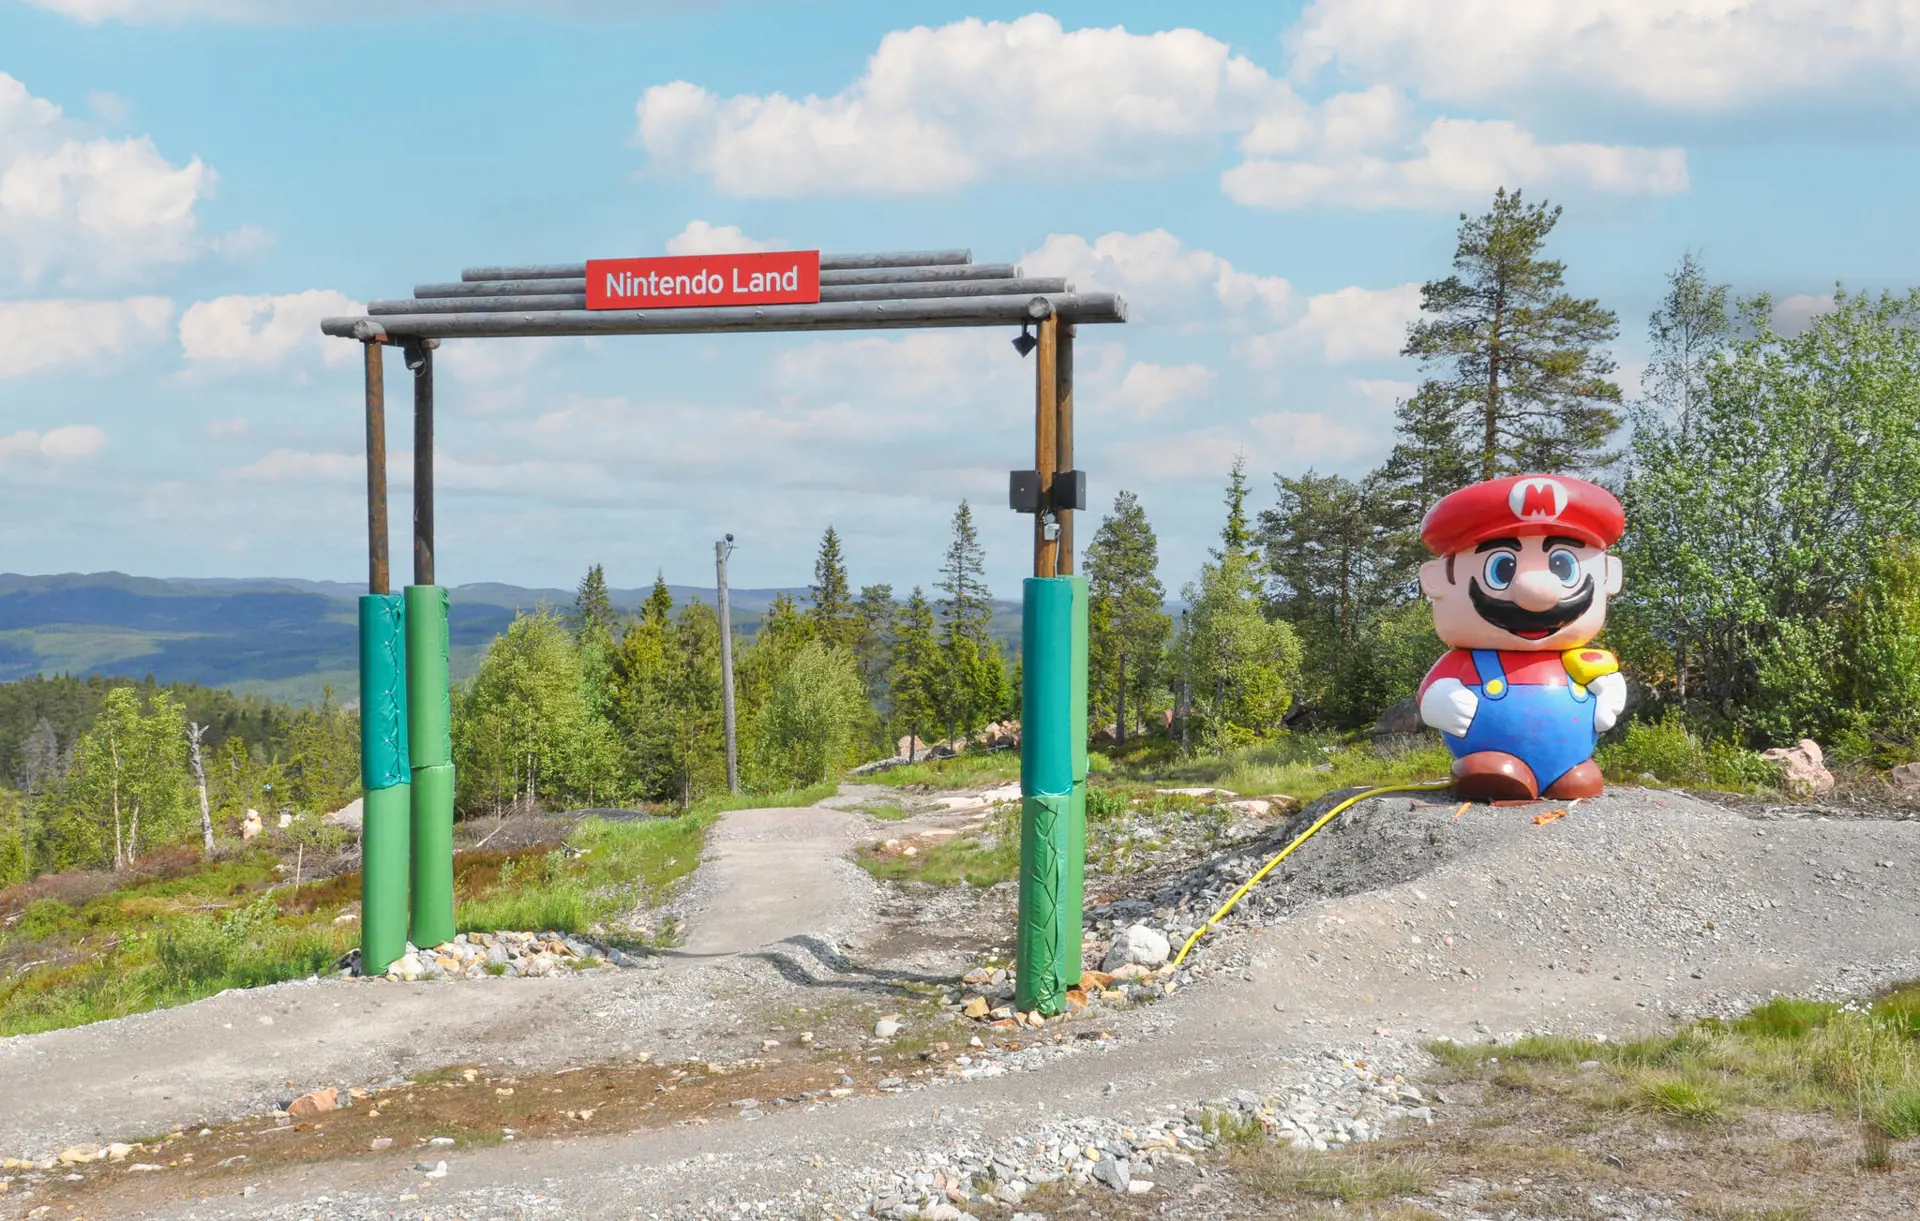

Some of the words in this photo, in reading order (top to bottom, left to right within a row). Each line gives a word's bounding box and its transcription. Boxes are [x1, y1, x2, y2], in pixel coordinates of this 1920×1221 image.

[606, 269, 724, 297] Nintendo
[732, 265, 798, 293] Land
[1522, 484, 1556, 516] M
